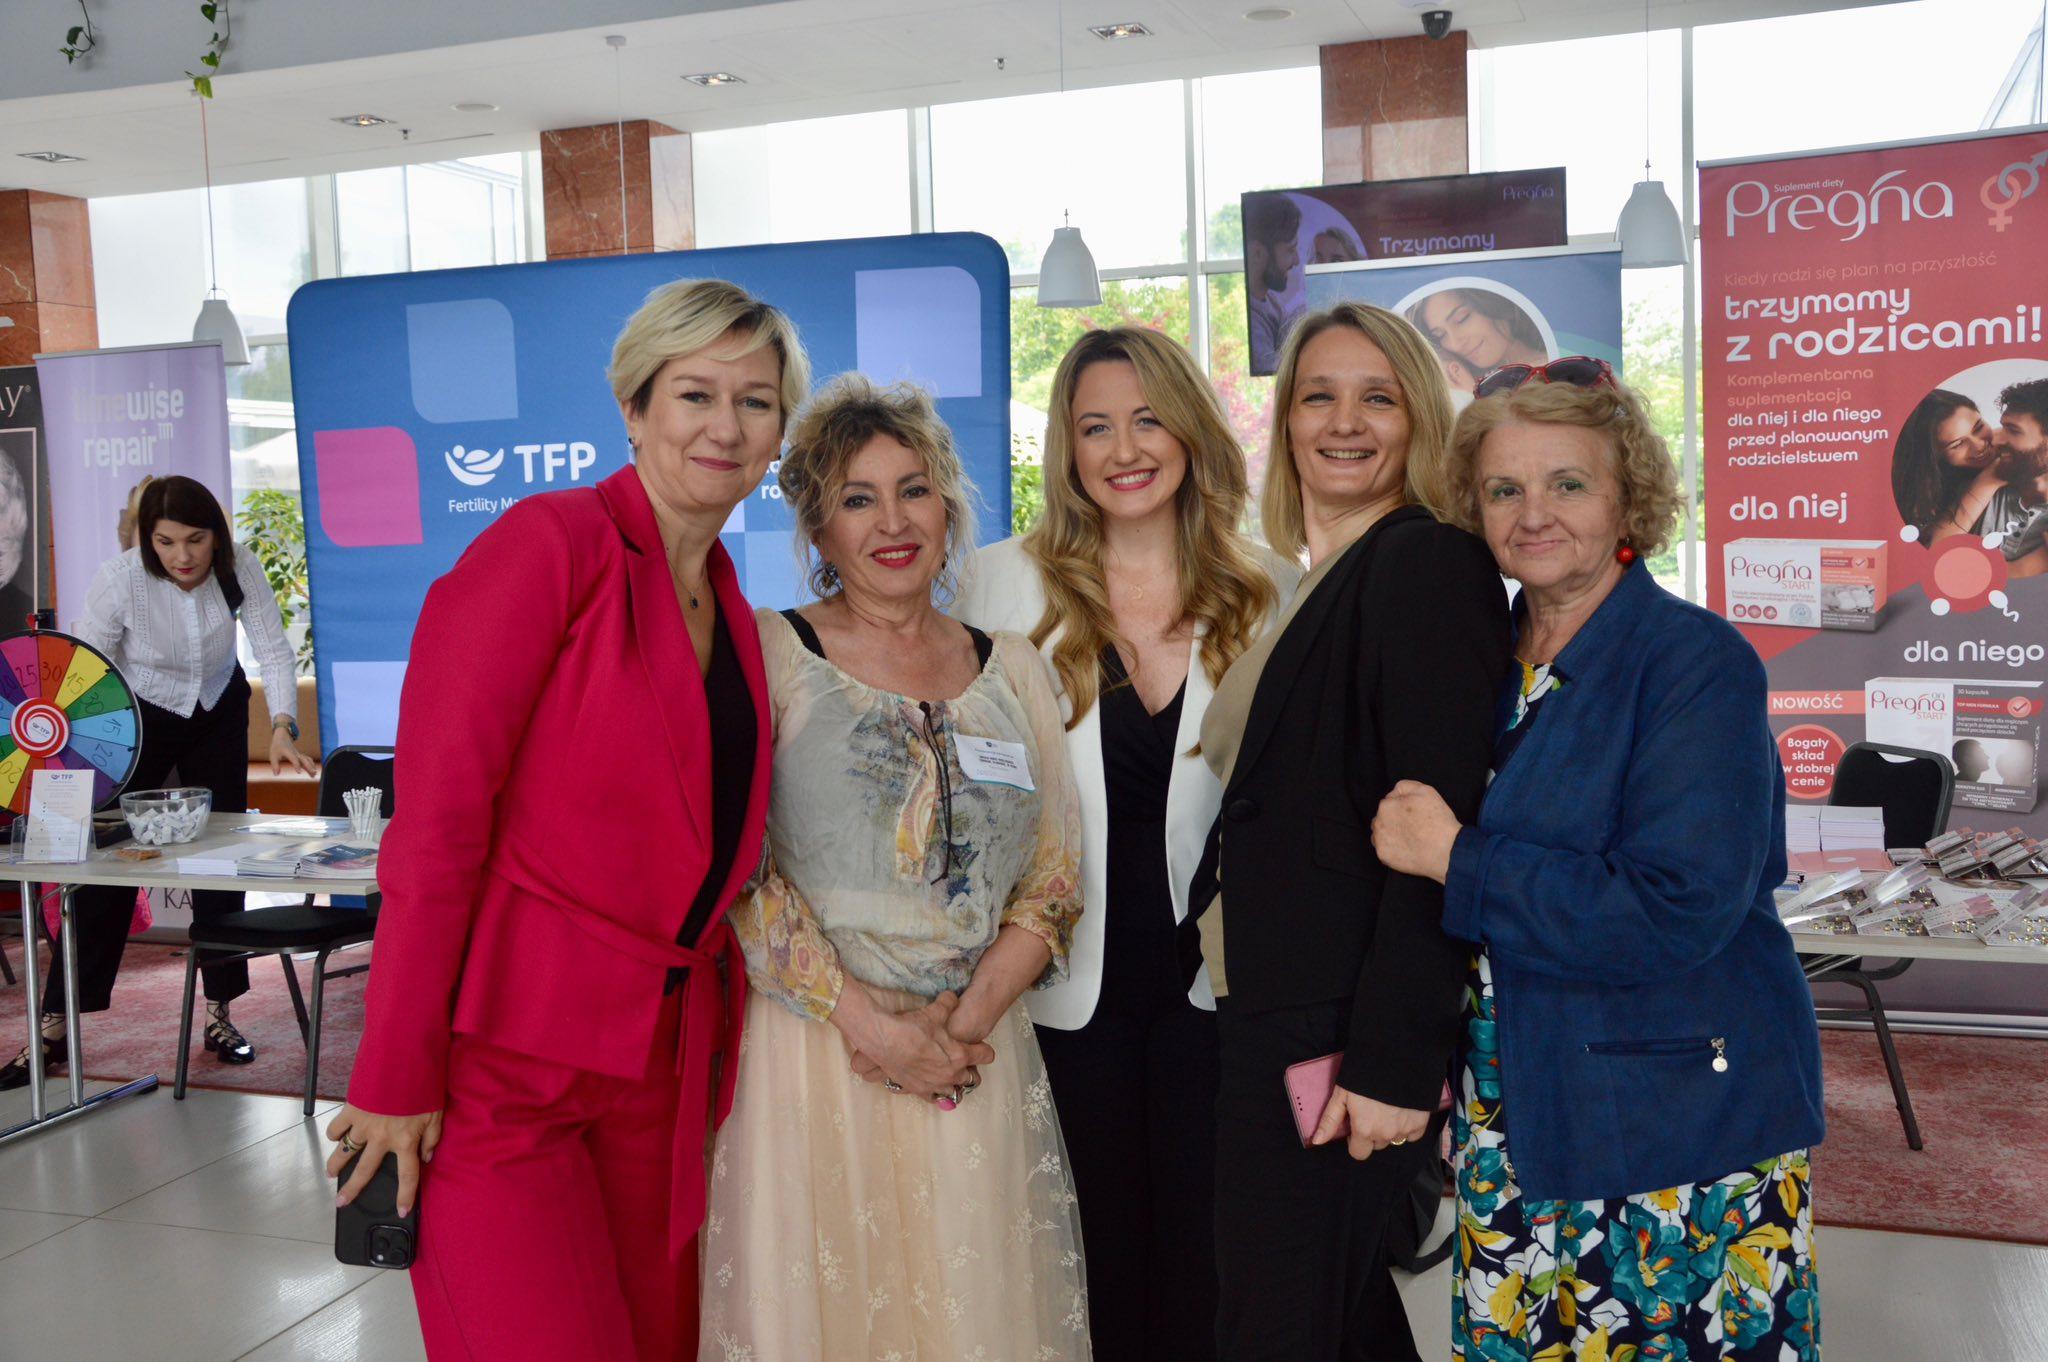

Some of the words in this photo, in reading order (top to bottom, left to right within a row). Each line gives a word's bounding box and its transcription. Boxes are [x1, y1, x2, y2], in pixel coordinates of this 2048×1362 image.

[1774, 180, 1820, 193] Suplement
[1822, 178, 1844, 188] diety
[1379, 233, 1495, 256] Trzymamy
[1724, 272, 1767, 288] Kiedy
[1772, 268, 1811, 284] rodzi
[1815, 267, 1837, 281] się
[1842, 263, 1879, 280] plan
[1884, 262, 1906, 275] na
[1912, 251, 1997, 275] przyszłość
[1725, 288, 1910, 323] trzymamy
[1726, 335, 1751, 362] z
[1769, 304, 2041, 359] rodzicami!
[1727, 368, 1874, 388] Komplementarna
[73, 382, 184, 422] timewise
[1727, 388, 1851, 409] suplementacja
[1728, 412, 1753, 427] dla
[1793, 410, 1797, 424] i
[1802, 409, 1828, 423] dla
[1728, 432, 1776, 450] przed
[1780, 428, 1888, 447] planowanym
[513, 441, 596, 483] TFP
[1728, 450, 1858, 467] rodzicielstwem
[448, 497, 497, 513] Fertility
[1729, 496, 1778, 521] dla
[1781, 580, 1811, 590] START
[1903, 640, 1948, 662] dla
[15, 665, 37, 687] 25
[41, 661, 62, 681] 30
[1773, 694, 1843, 709] NOWOŚĆ
[1787, 738, 1829, 749] Bogaty
[1792, 750, 1825, 761] skład
[1783, 765, 1792, 773] w
[1795, 763, 1834, 775] dobrej
[1792, 776, 1825, 786] cenie
